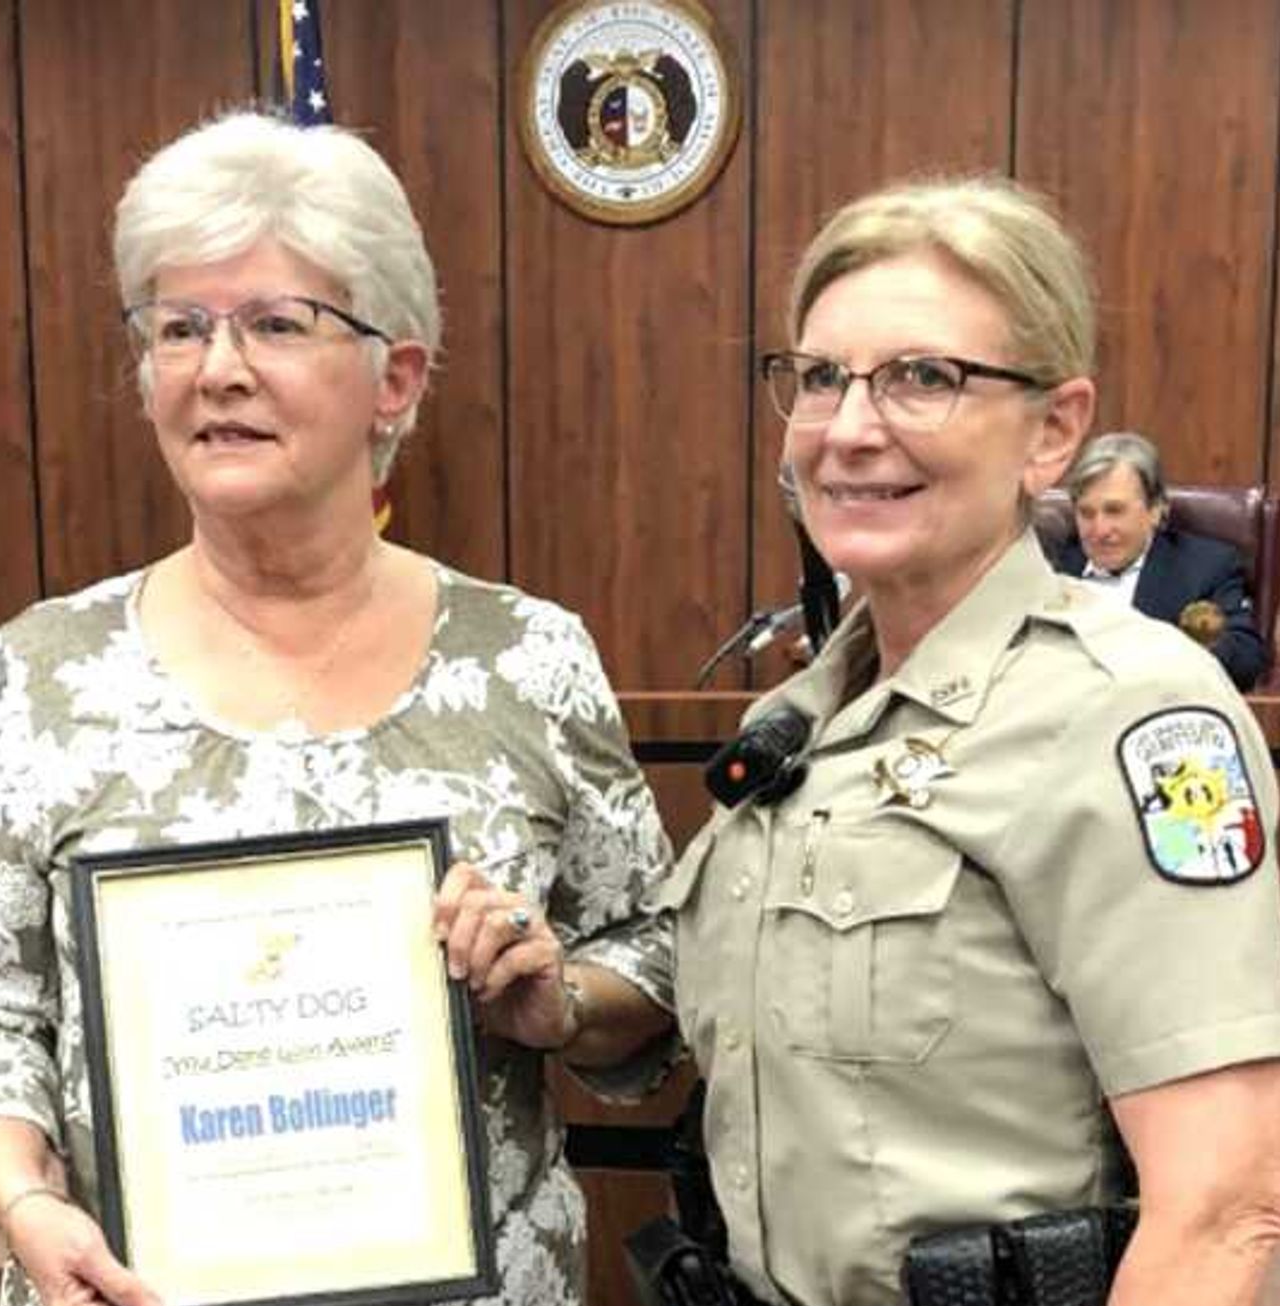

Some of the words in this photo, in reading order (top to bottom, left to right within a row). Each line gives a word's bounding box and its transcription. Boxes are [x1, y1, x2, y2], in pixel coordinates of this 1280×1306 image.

[186, 997, 289, 1033] SALTY
[297, 986, 368, 1020] DOG
[180, 1101, 263, 1146] Karen
[268, 1086, 398, 1137] Bollinger
